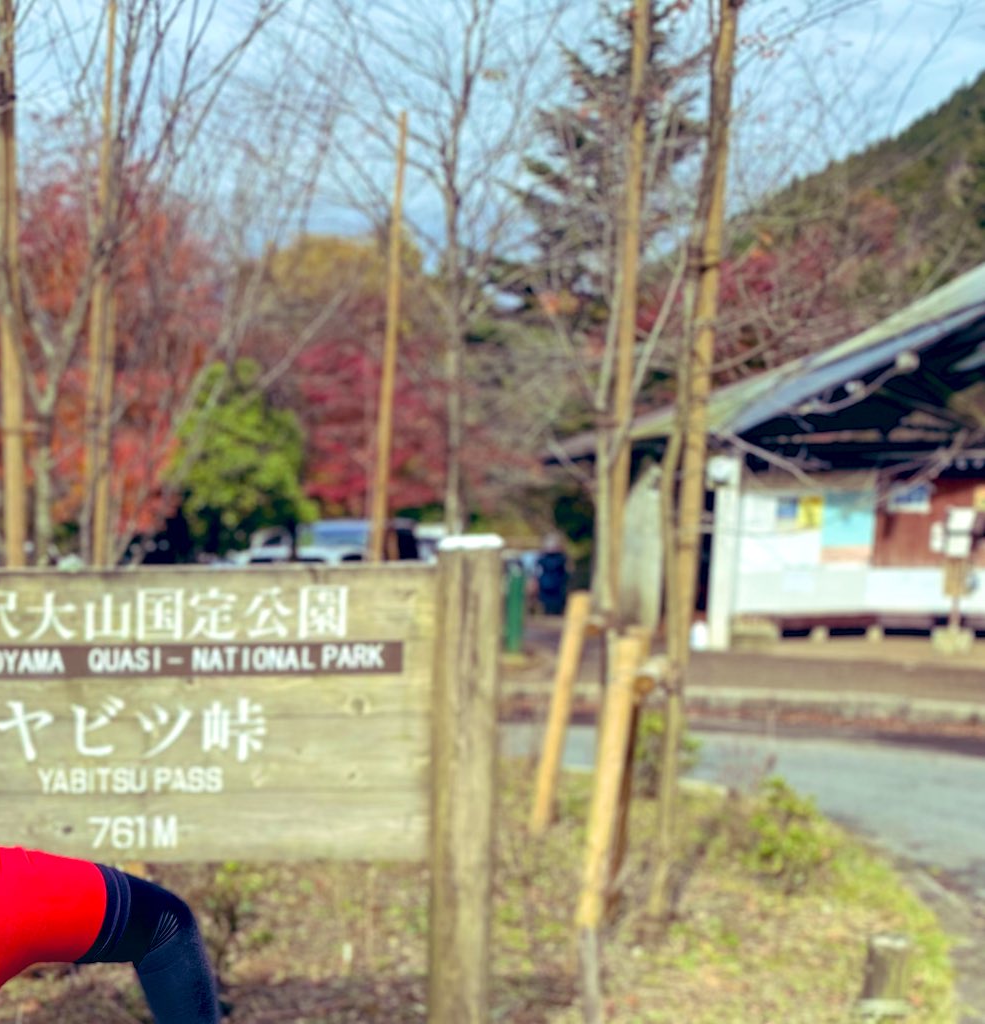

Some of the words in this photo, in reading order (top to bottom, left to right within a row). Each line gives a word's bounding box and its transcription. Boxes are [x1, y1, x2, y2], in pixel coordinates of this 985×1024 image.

[87, 646, 161, 673] QUASI
[191, 645, 316, 672] NATIONAL
[321, 642, 385, 669] PARK
[37, 767, 148, 795] YABITSU
[153, 765, 224, 793] PASS
